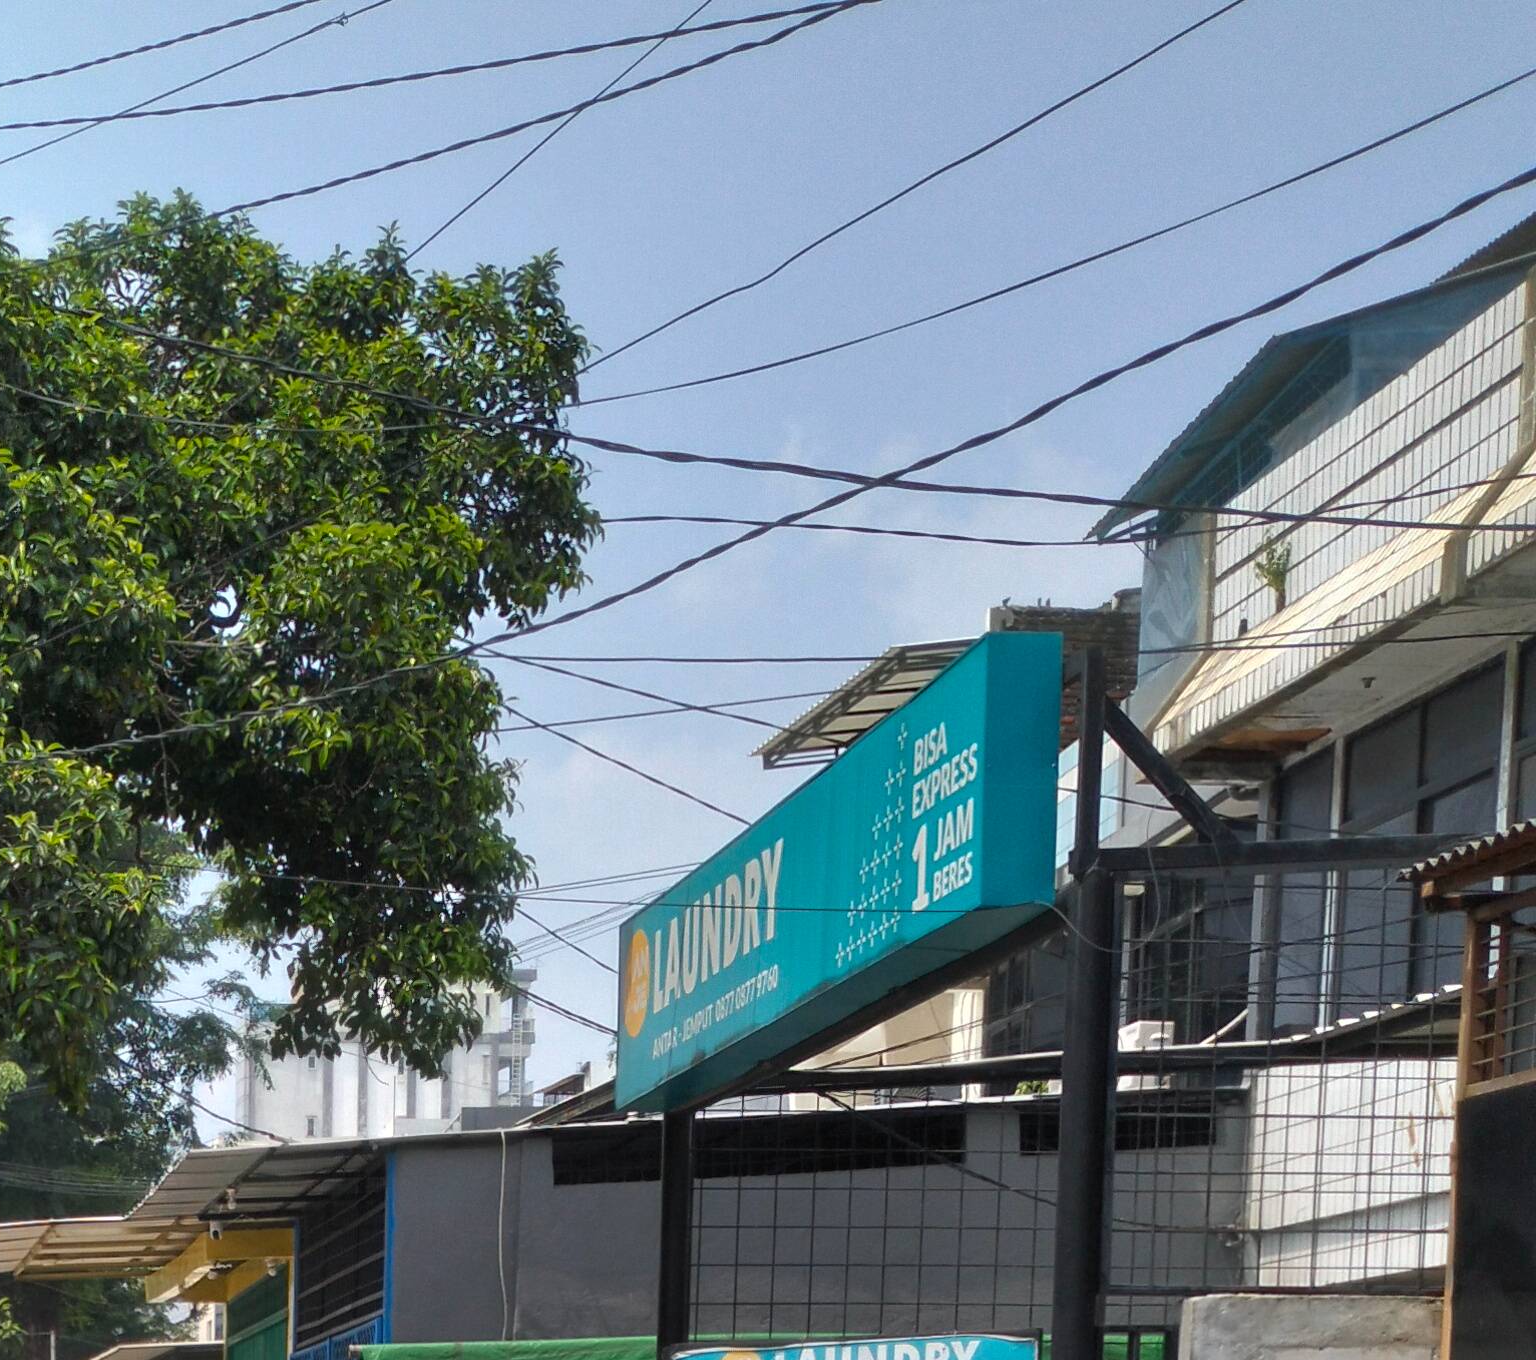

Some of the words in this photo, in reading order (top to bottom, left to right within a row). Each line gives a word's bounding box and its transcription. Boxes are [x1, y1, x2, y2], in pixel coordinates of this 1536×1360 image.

[911, 742, 978, 820] EXPRESS
[914, 721, 948, 777] BISA
[911, 823, 930, 913] 1
[933, 797, 974, 862] JAM
[932, 851, 973, 903] BERES
[653, 837, 784, 1015] LAUNDRY
[682, 1004, 713, 1042] JEMPUT
